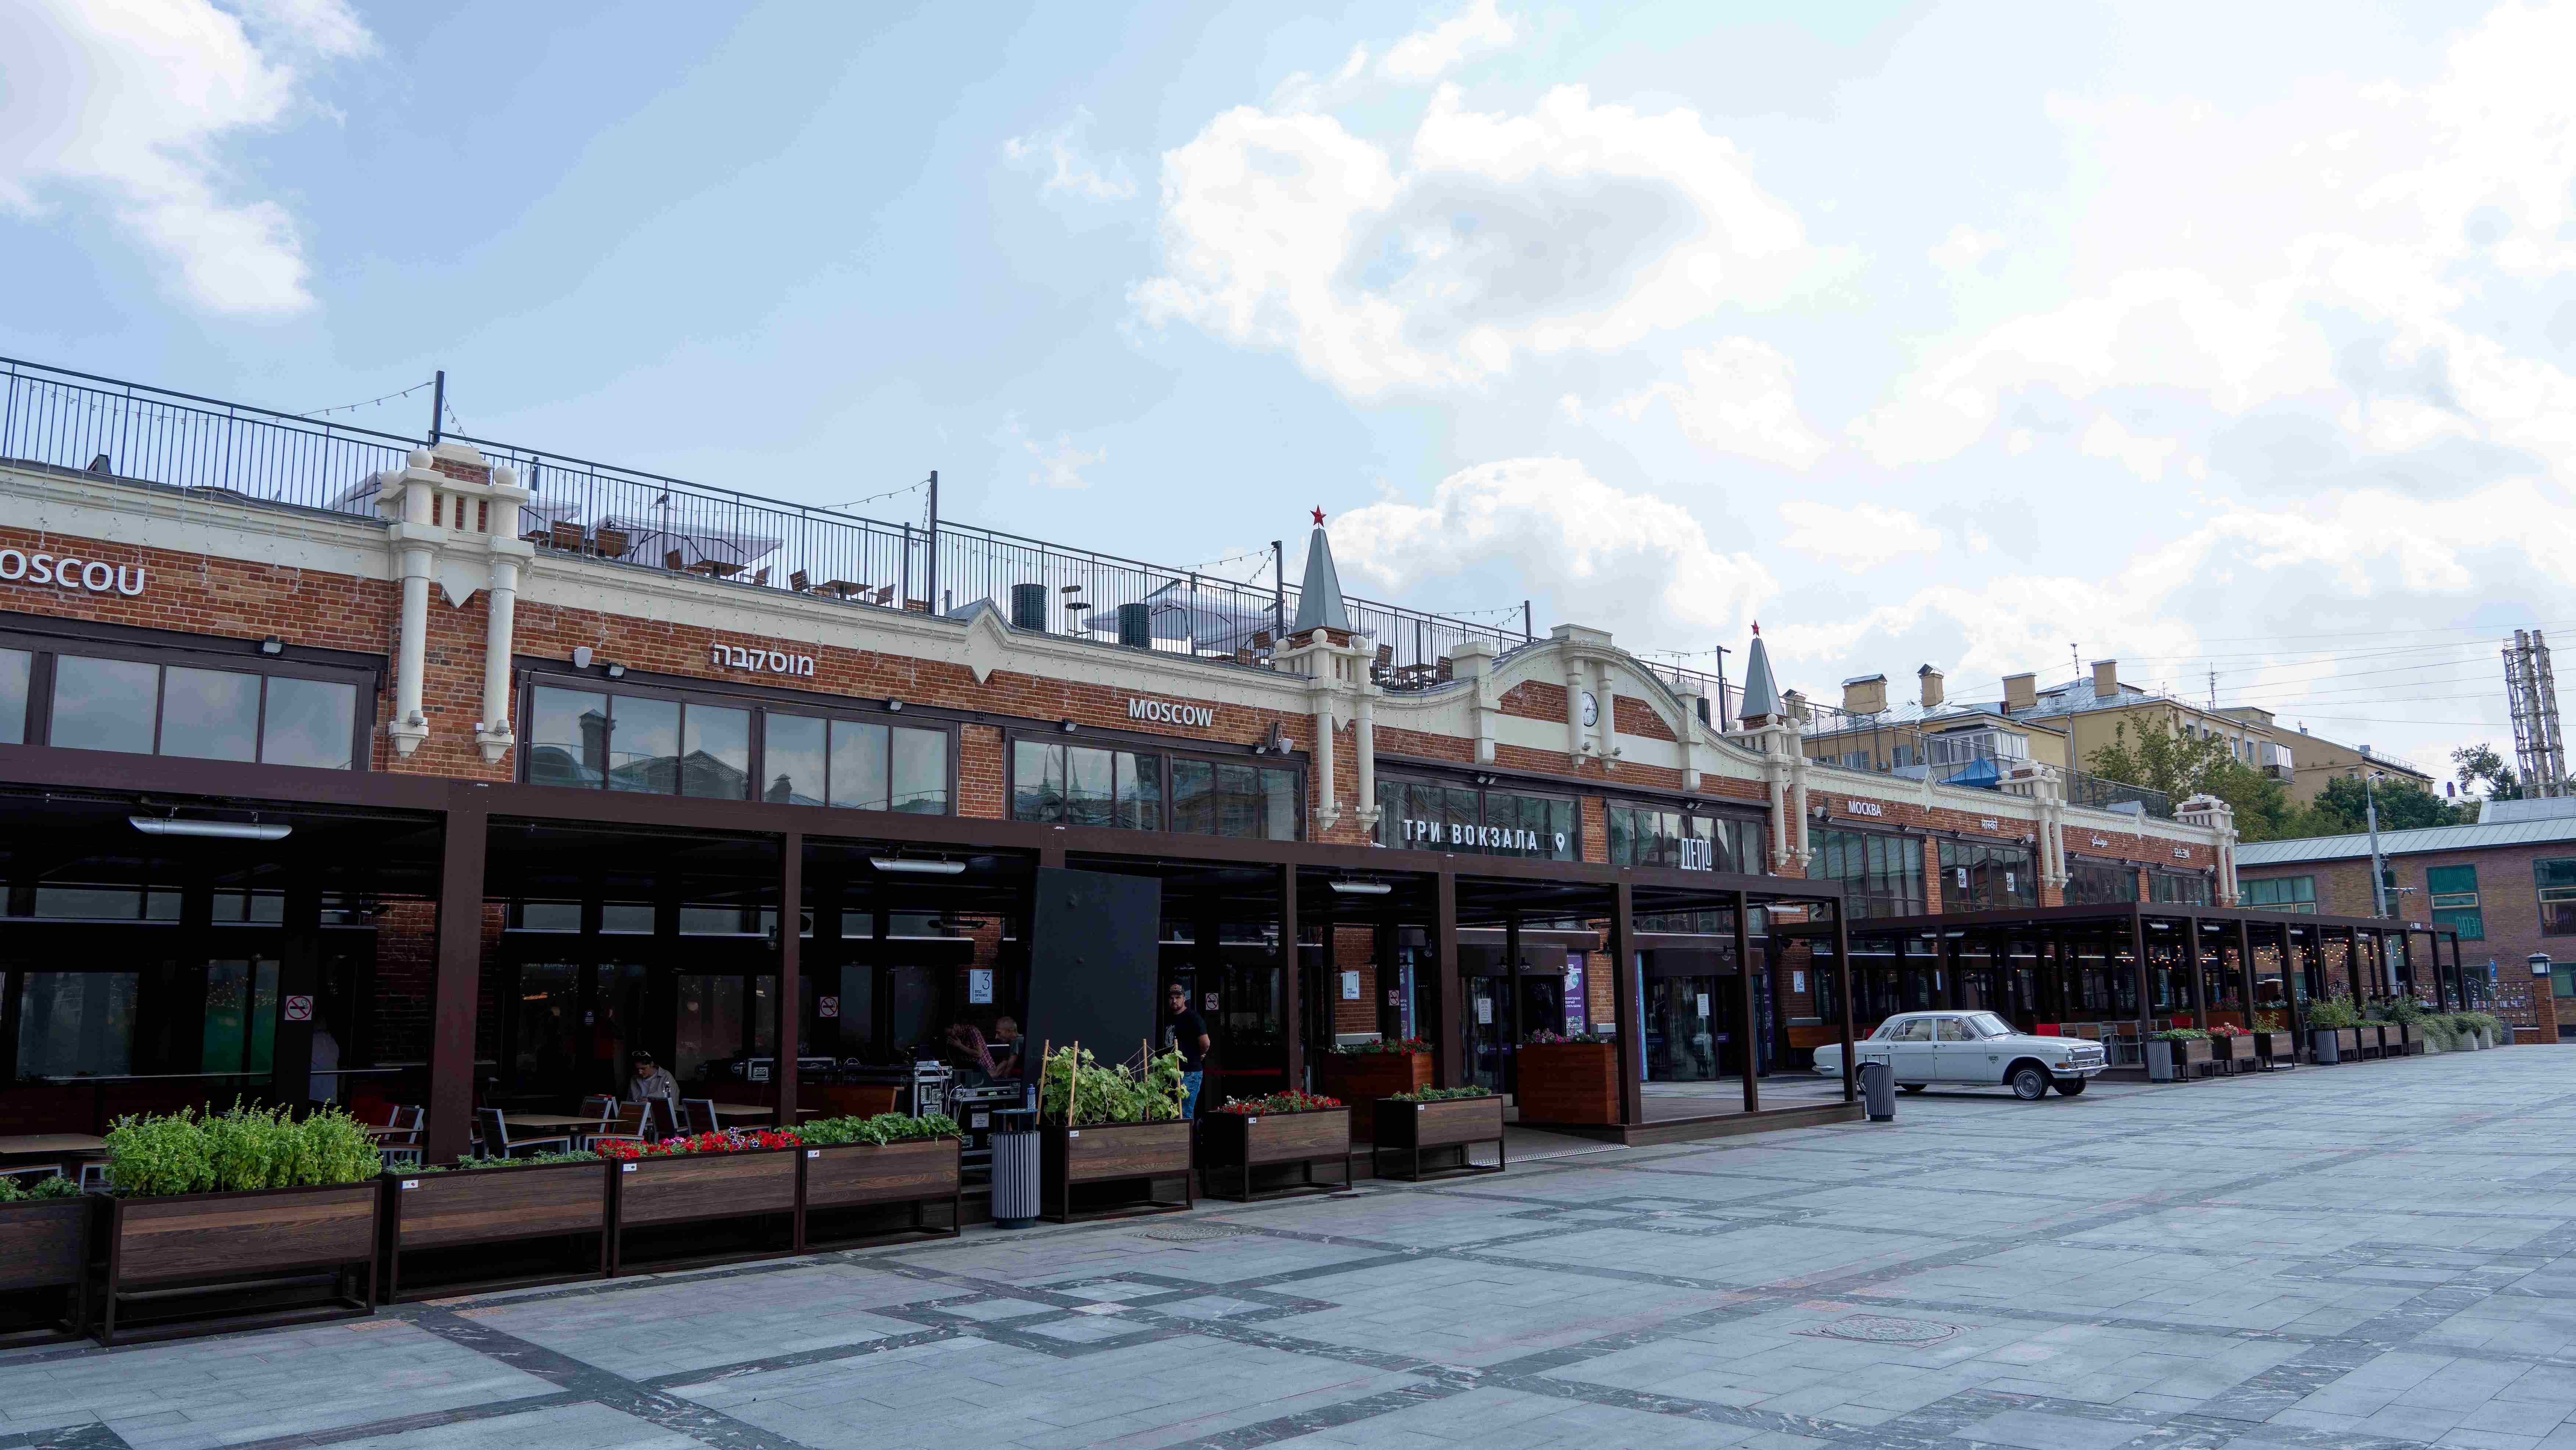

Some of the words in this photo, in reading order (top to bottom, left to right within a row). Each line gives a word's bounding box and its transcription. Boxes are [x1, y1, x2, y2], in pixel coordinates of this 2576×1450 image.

[714, 644, 813, 676] מוסקבה
[1129, 698, 1213, 727] MOSCOW
[1848, 800, 1882, 817] МОСКВА
[1404, 819, 1440, 842] ТРИ
[1452, 824, 1538, 850] ВОКЗАЛА
[983, 972, 990, 989] 3
[1353, 973, 1357, 988] 1
